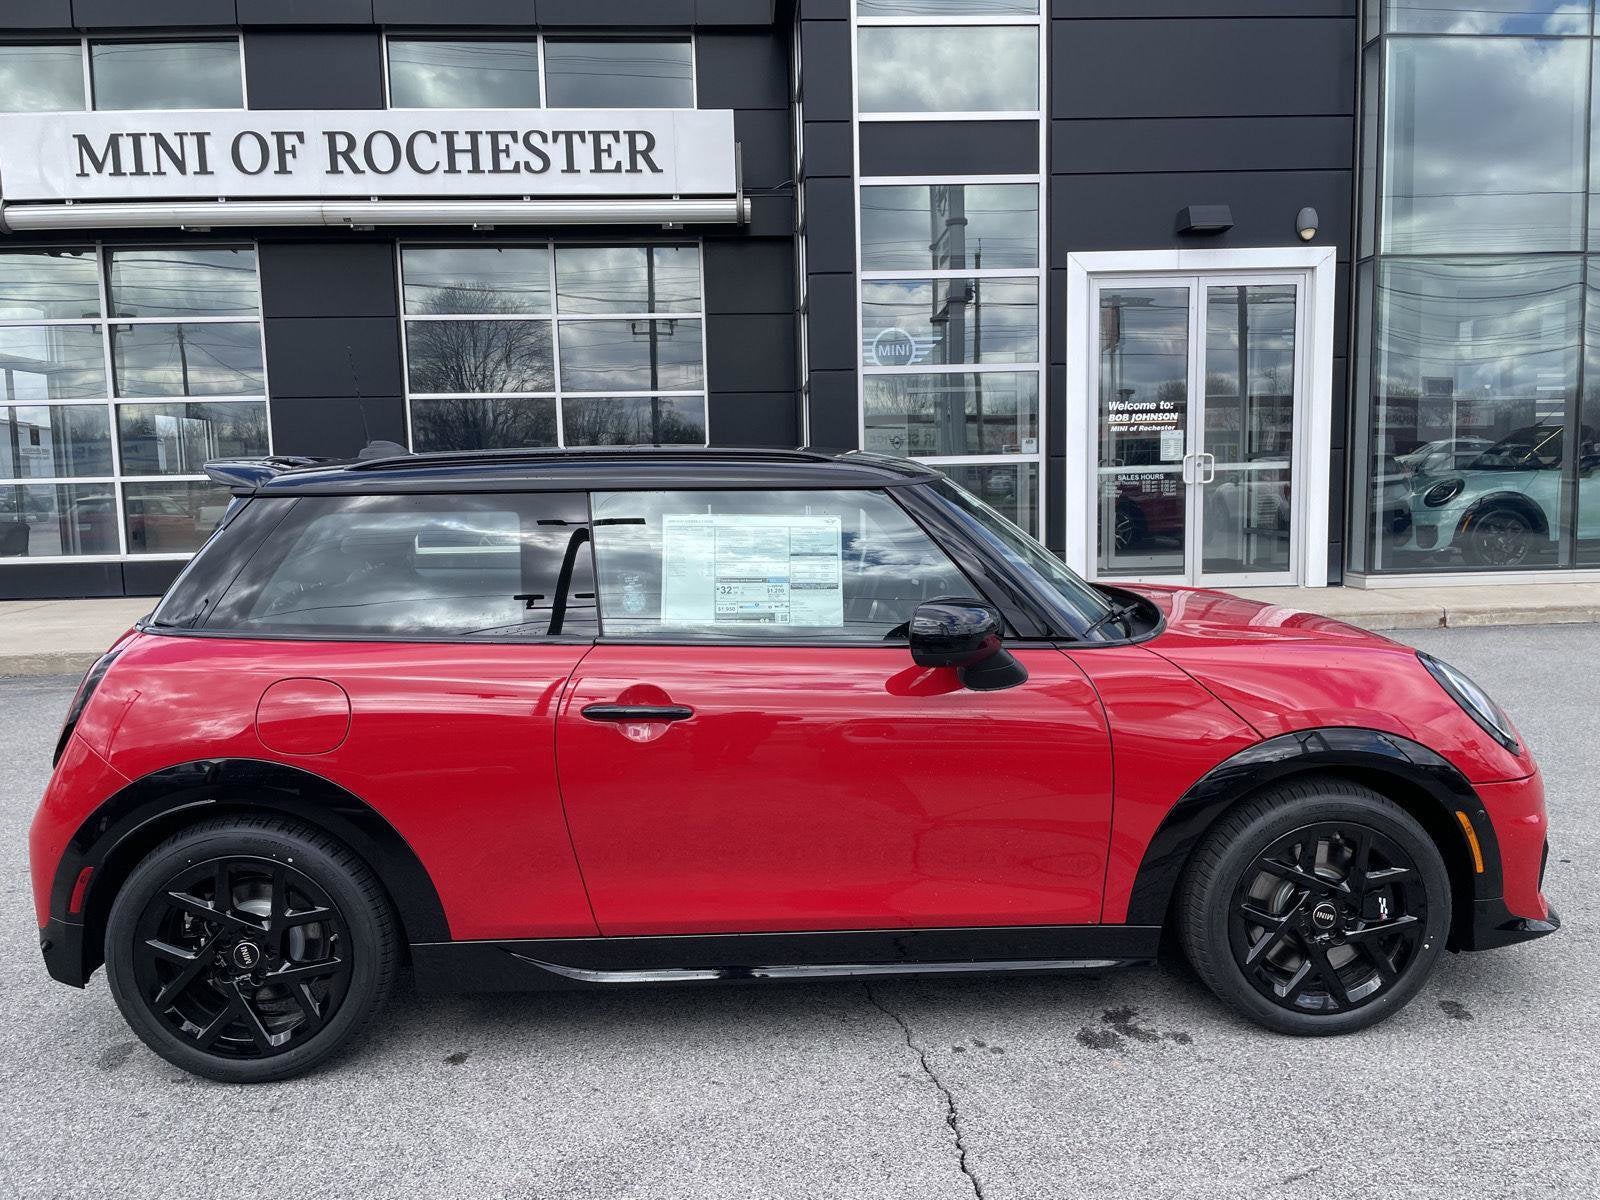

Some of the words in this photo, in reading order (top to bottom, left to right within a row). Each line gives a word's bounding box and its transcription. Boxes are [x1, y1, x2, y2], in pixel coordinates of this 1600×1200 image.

[72, 132, 215, 177] MINI
[230, 130, 305, 176] OF
[321, 129, 664, 175] ROCHESTER
[878, 344, 910, 357] MINI
[1108, 401, 1157, 411] Welcome
[1160, 401, 1174, 410] to:
[1108, 413, 1130, 422] BOB
[1131, 412, 1179, 423] JOHNSON
[720, 585, 732, 595] 32
[1316, 911, 1335, 921] MINI
[240, 946, 253, 965] MINI
